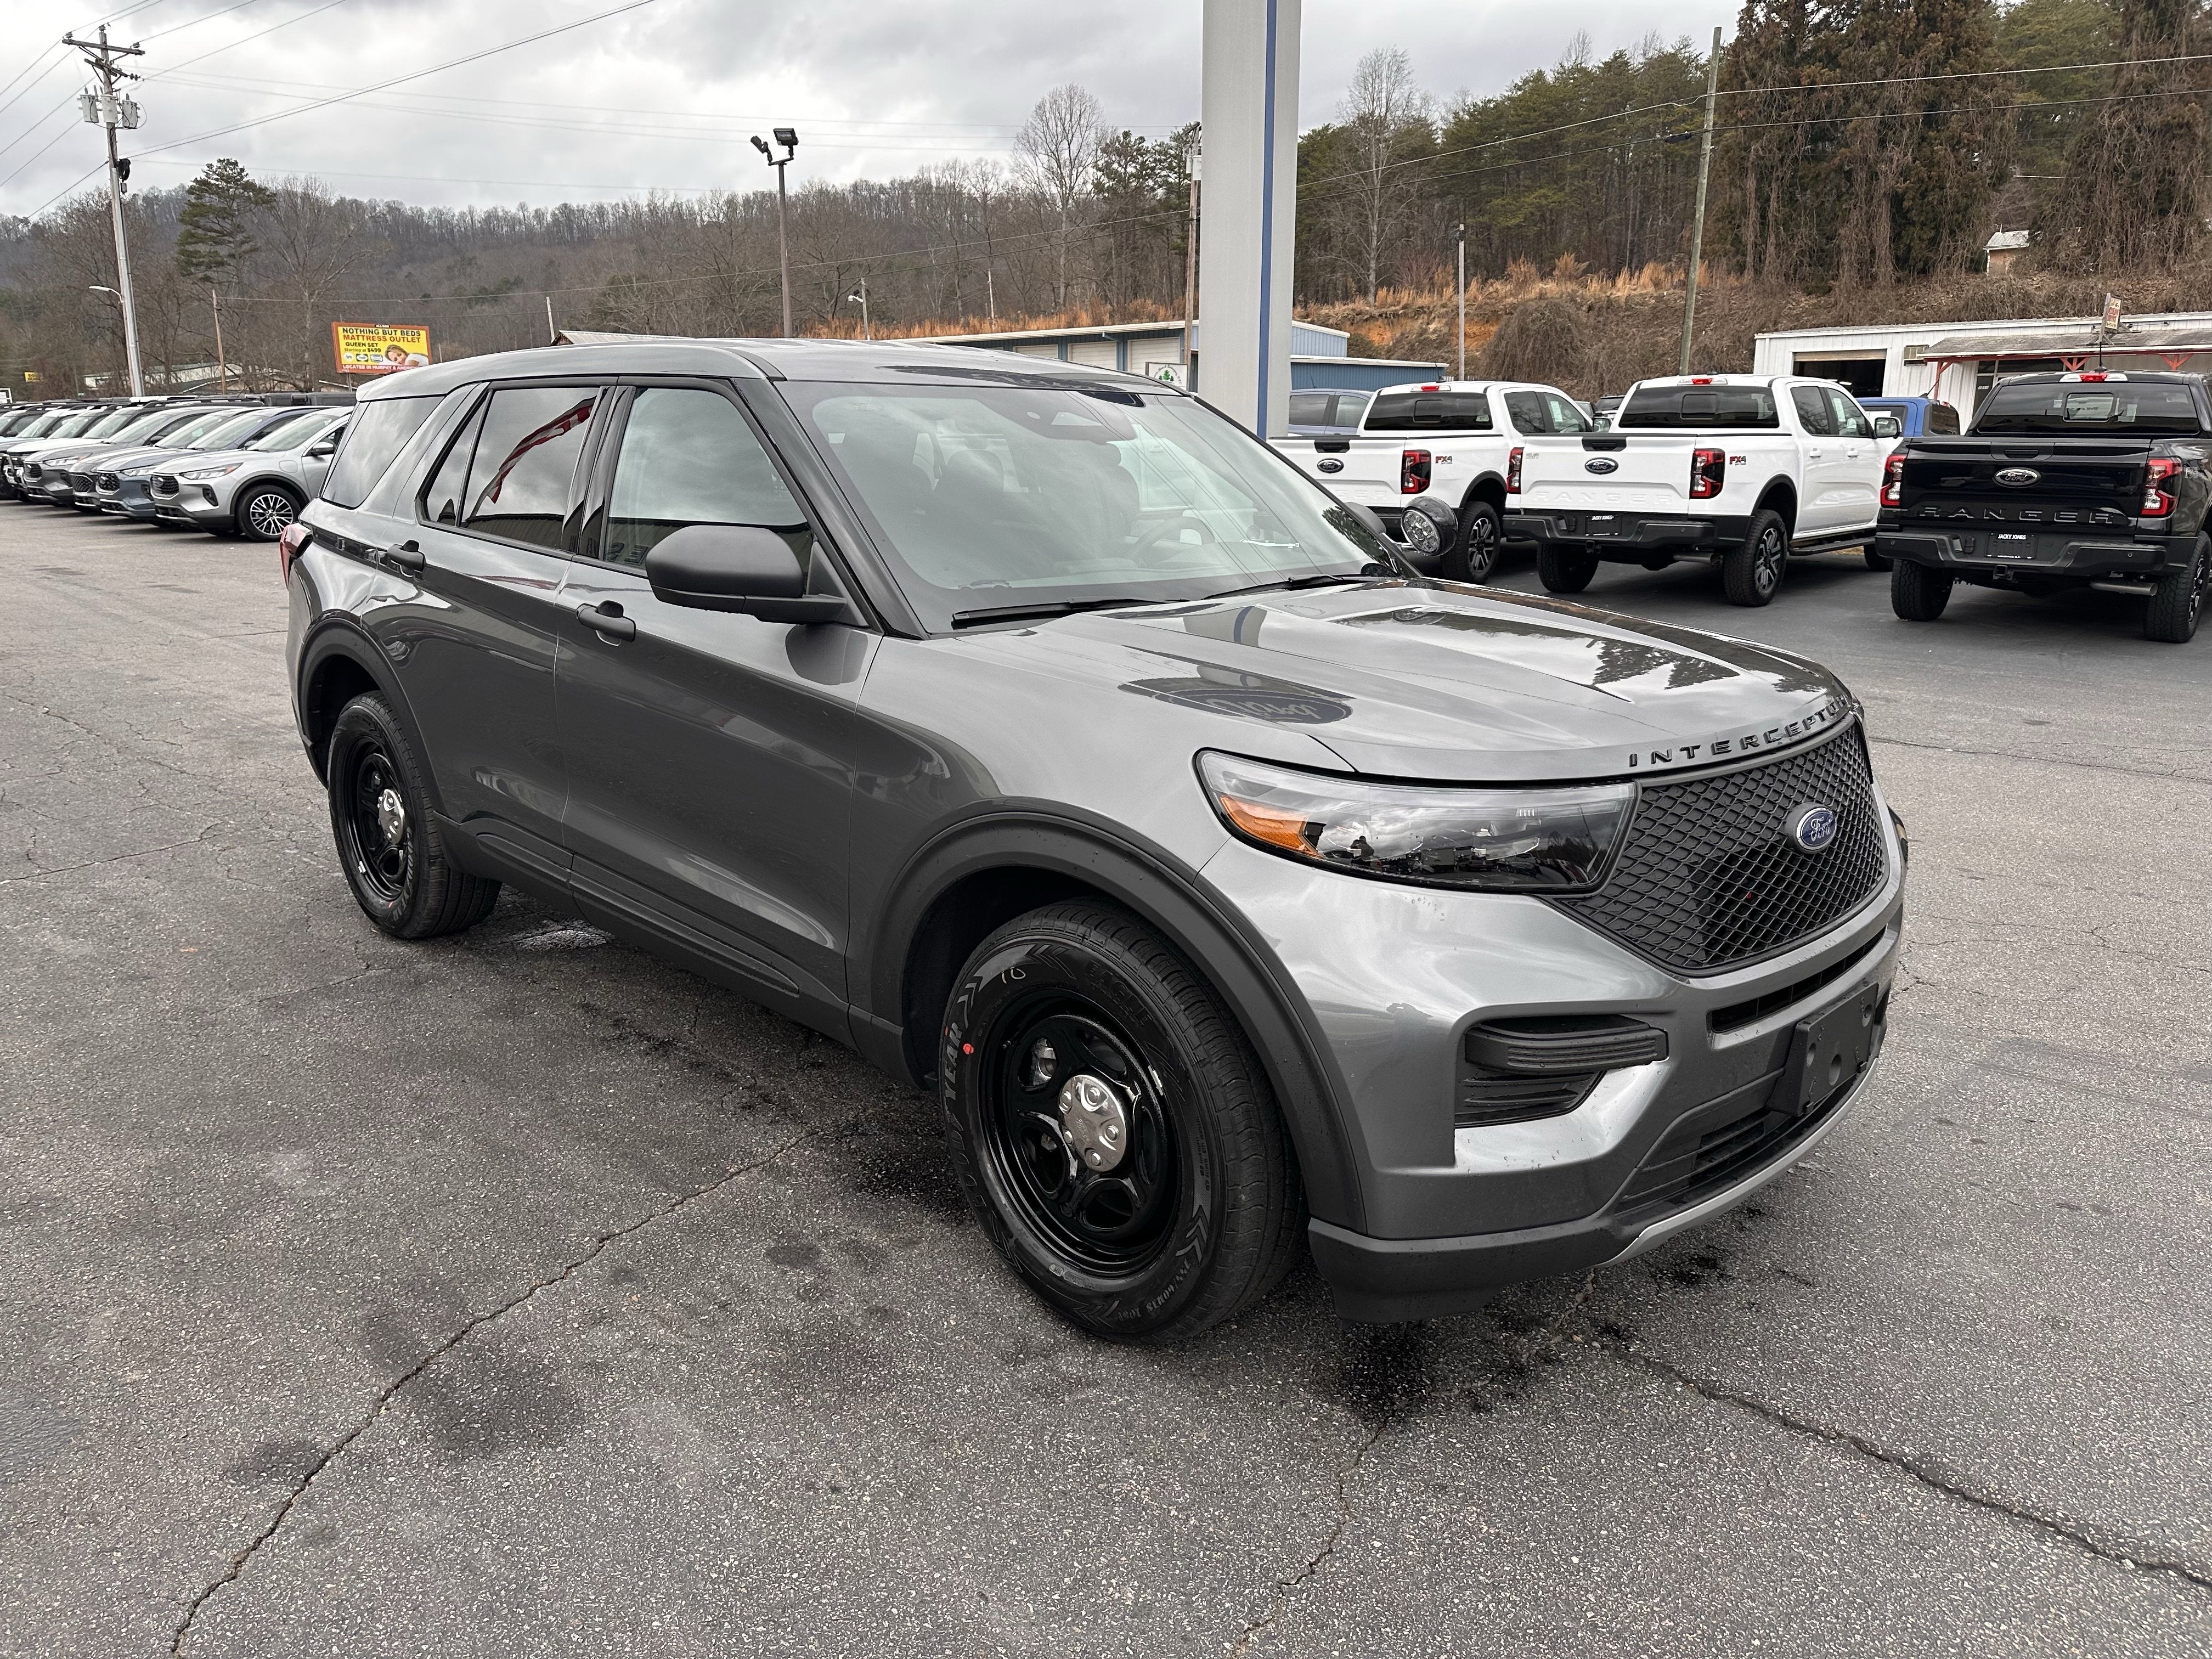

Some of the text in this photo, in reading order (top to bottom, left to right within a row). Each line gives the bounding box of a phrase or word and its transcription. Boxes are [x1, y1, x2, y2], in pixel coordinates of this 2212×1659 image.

[1730, 456, 1746, 465] FX4
[2005, 472, 2028, 481] Ford
[1533, 492, 1673, 505] RANGER
[1920, 507, 2113, 523] RANGER
[1629, 694, 1849, 768] INTERCEPTOR
[1809, 815, 1833, 842] Ford
